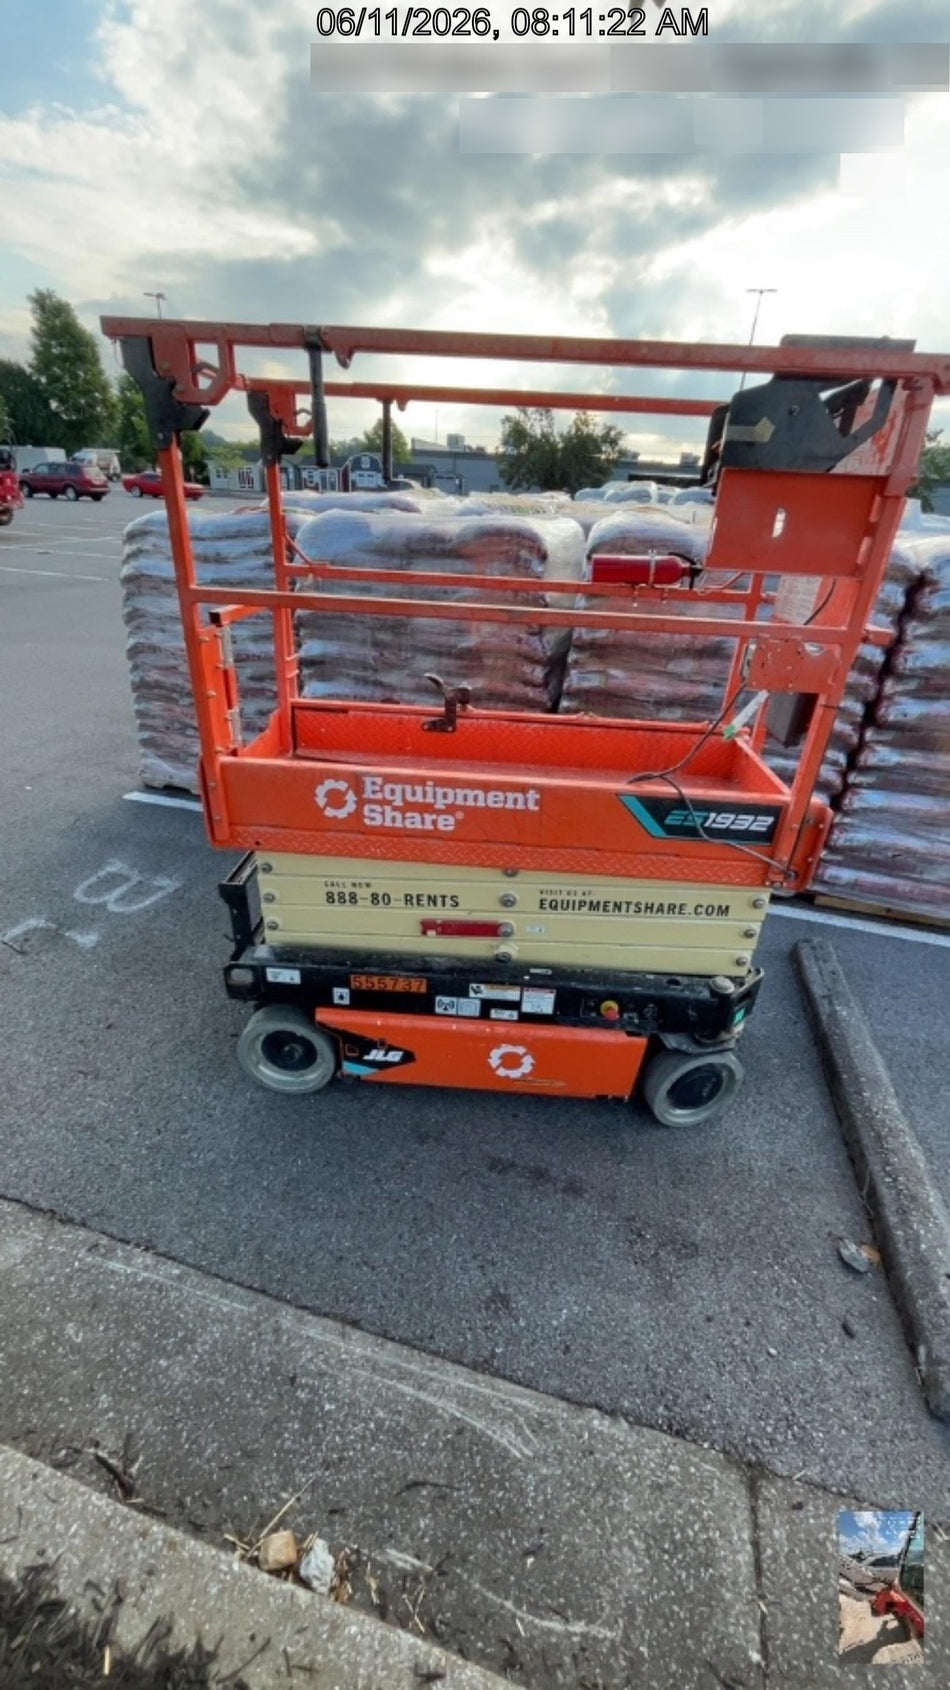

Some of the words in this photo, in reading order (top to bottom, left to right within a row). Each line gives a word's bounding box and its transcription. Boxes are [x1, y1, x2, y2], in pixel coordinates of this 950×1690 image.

[362, 776, 540, 811] Equipment
[664, 810, 774, 831] ES1932
[325, 891, 460, 908] 888-80-RENTS
[539, 898, 731, 917] EQUIPMENTSHARE.COM
[352, 975, 424, 991] 555737
[363, 1049, 404, 1061] JLG
